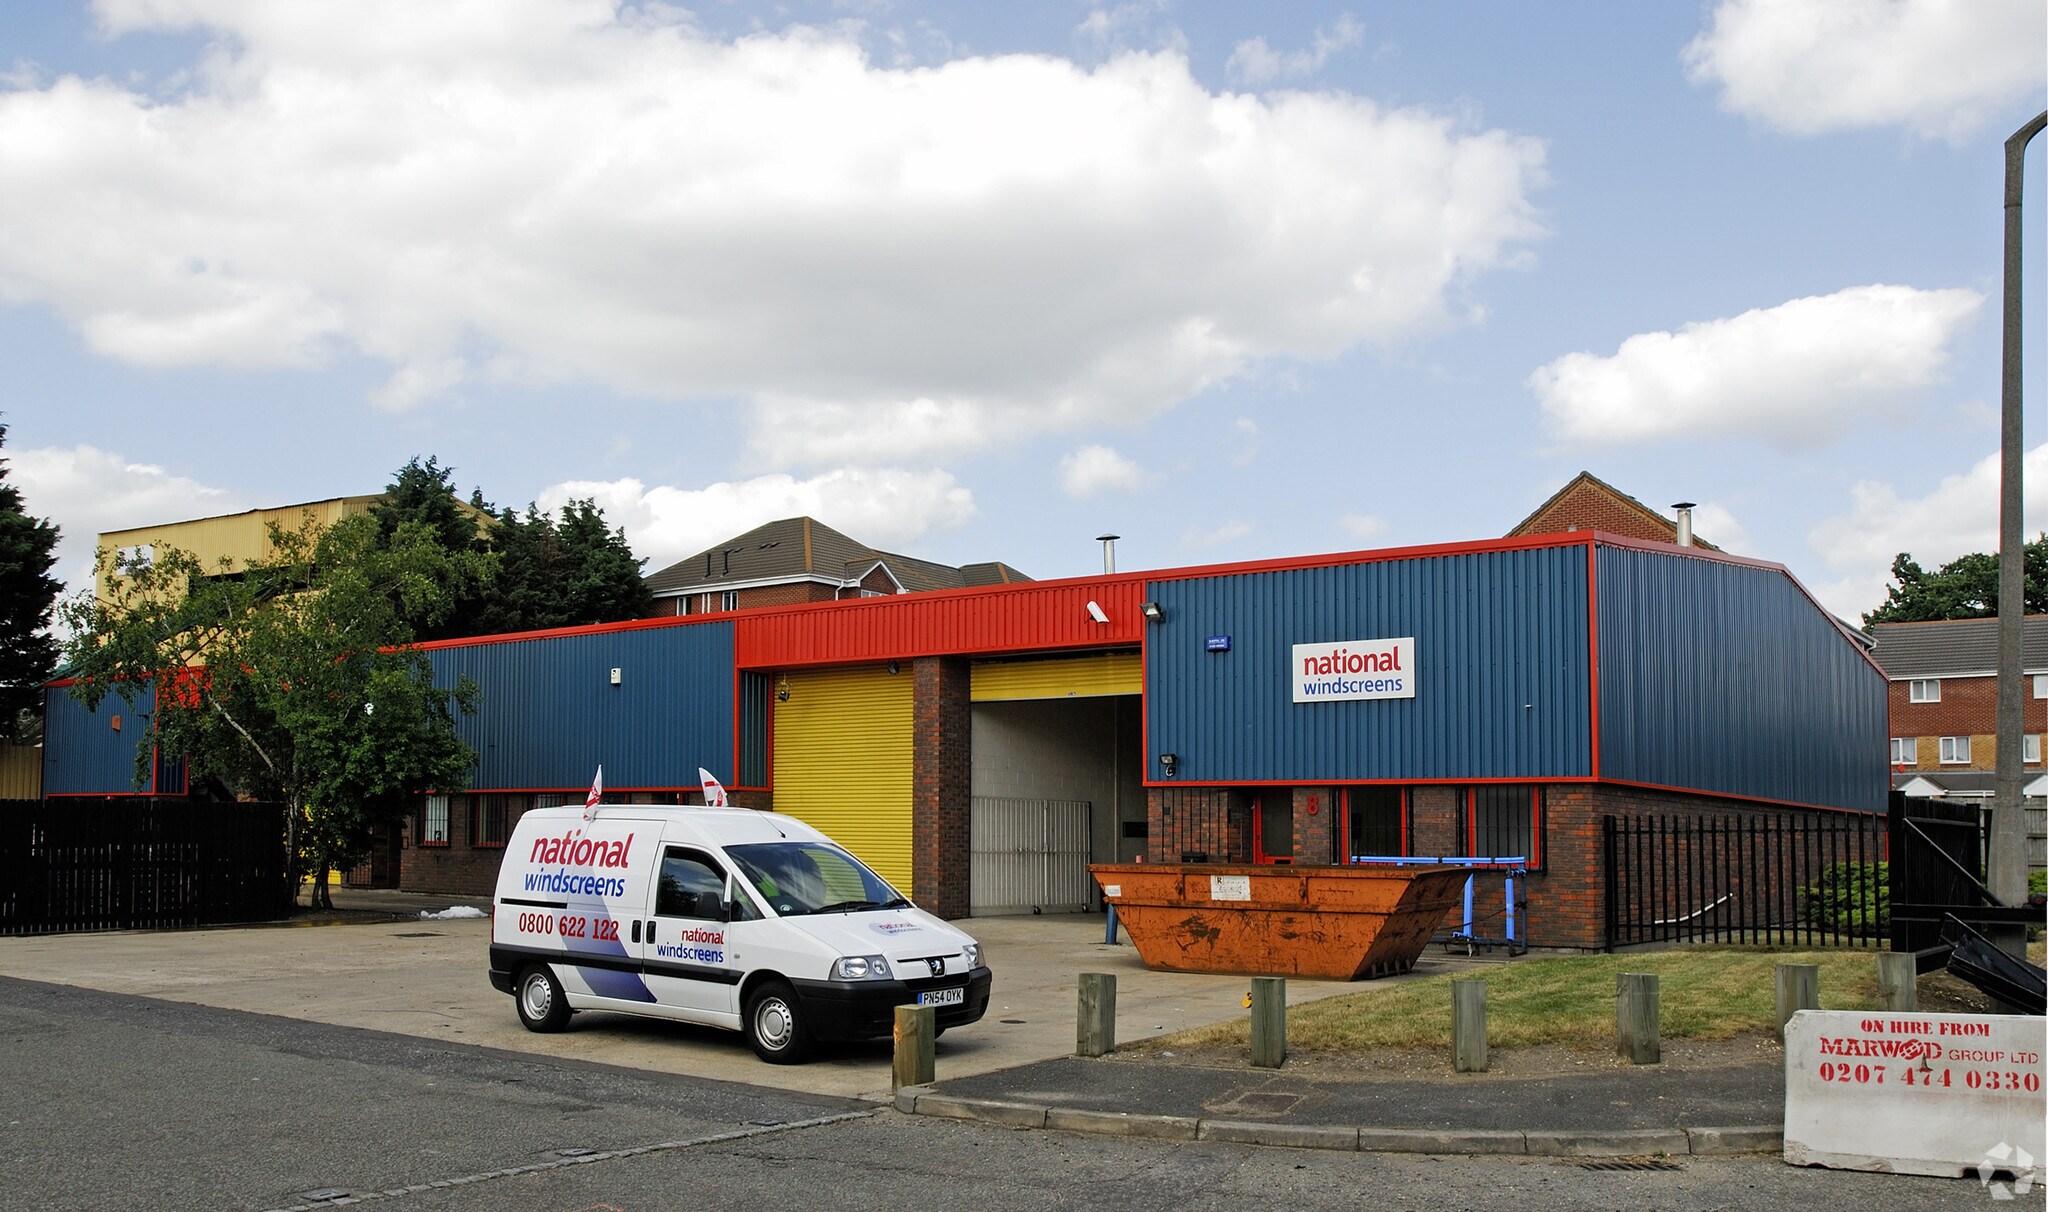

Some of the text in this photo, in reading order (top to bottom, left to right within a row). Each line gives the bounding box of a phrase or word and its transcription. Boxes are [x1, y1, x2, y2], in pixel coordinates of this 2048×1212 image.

[1304, 646, 1401, 675] national
[1304, 677, 1403, 695] windscreens
[1306, 795, 1319, 815] 8
[530, 829, 634, 868] national
[524, 868, 625, 897] windscreens
[519, 912, 619, 942] 0800 622 122
[681, 927, 725, 945] national
[657, 941, 724, 963] windscreens
[923, 992, 945, 1005] PN54
[1861, 1019, 1990, 1037] ON HIRE FROM
[1948, 1049, 2005, 1063] GROUP
[2010, 1052, 2040, 1065] LTD
[1819, 1062, 2041, 1093] 0207 474 0330
